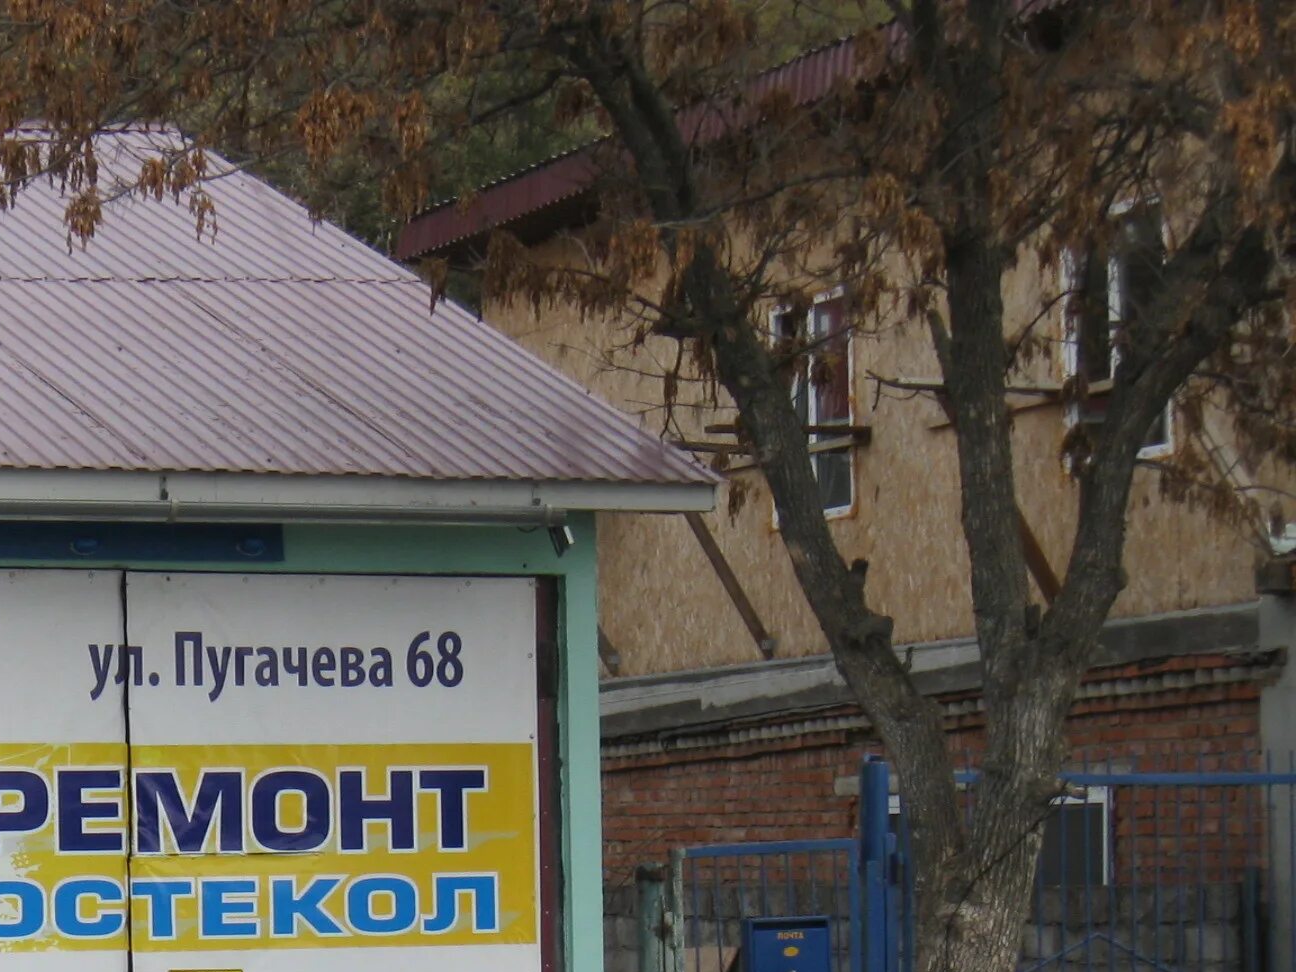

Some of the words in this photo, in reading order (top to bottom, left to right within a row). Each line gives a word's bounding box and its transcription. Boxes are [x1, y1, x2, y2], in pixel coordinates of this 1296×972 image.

[89, 643, 160, 701] ул.
[174, 631, 393, 703] Пугачева
[406, 630, 464, 688] 68
